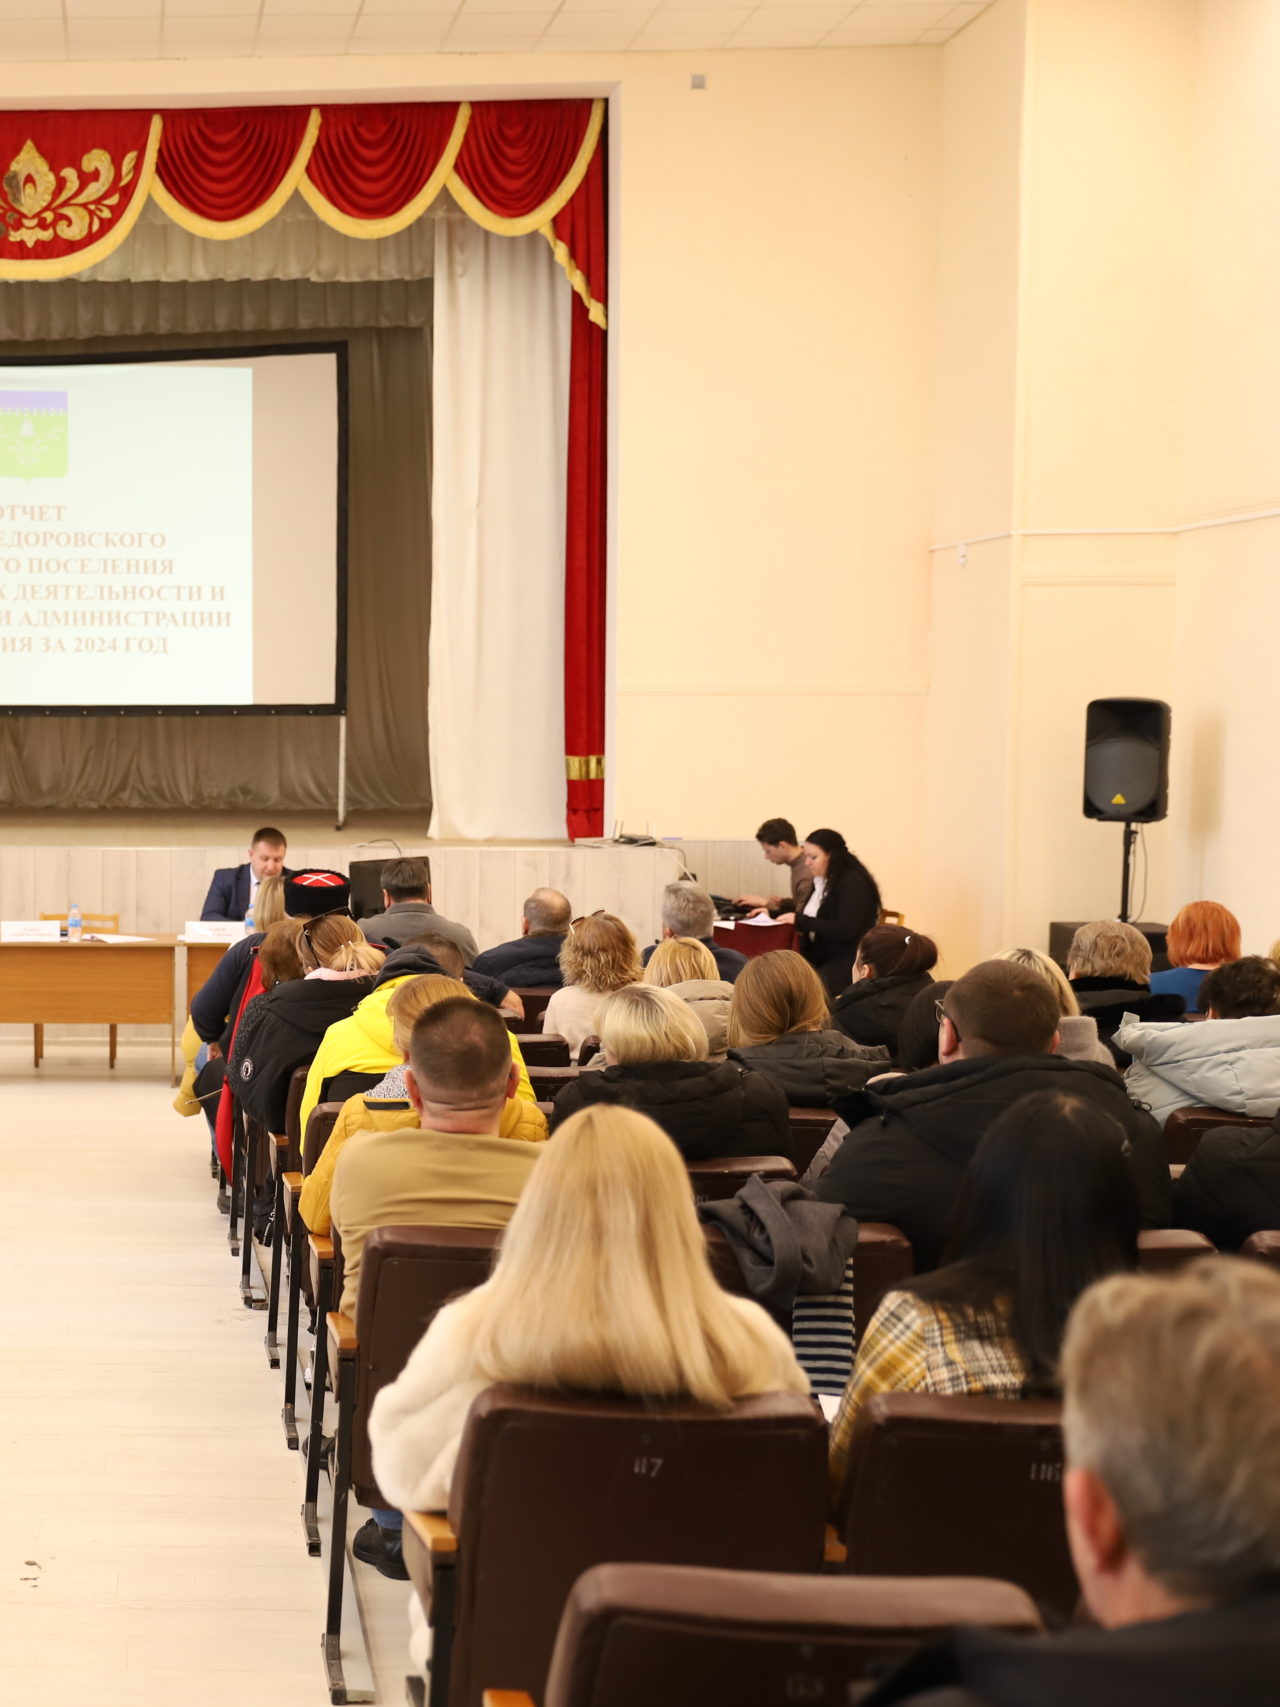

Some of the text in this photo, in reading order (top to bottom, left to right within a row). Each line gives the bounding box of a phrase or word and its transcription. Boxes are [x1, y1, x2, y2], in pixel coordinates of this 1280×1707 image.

[27, 557, 175, 575] ПОСЕЛЕНИЯ
[12, 584, 203, 603] ДЕЯТЕЛЬНОСТИ
[209, 585, 226, 601] И
[18, 610, 232, 628] АДМИНИСТРАЦИИ
[40, 636, 67, 653] ЗА
[74, 636, 118, 653] 2024
[124, 636, 169, 656] ГОД
[632, 1455, 664, 1478] 117
